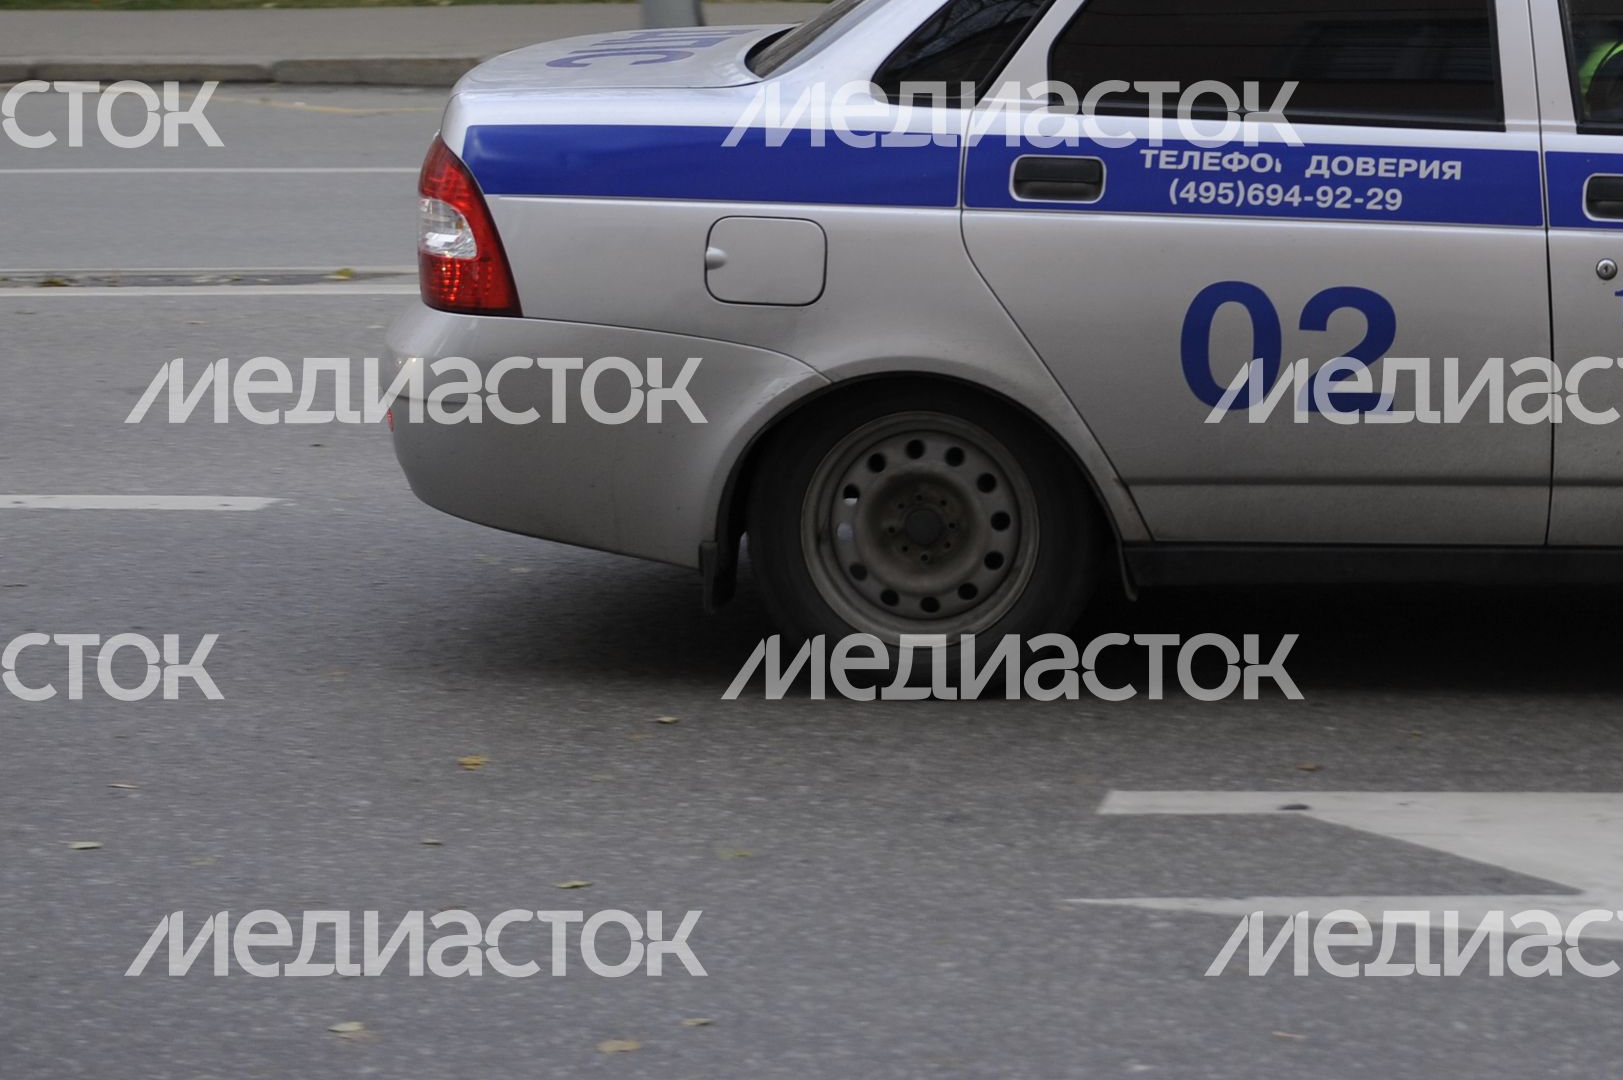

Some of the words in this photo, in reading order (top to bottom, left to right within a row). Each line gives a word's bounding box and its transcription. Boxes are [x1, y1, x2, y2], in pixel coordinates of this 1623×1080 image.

[1140, 149, 1282, 174] ТЕЛЕФО
[1305, 155, 1463, 181] ДОВЕРИЯ
[1169, 178, 1403, 212] (495)694-92-29
[1180, 280, 1398, 416] 02
